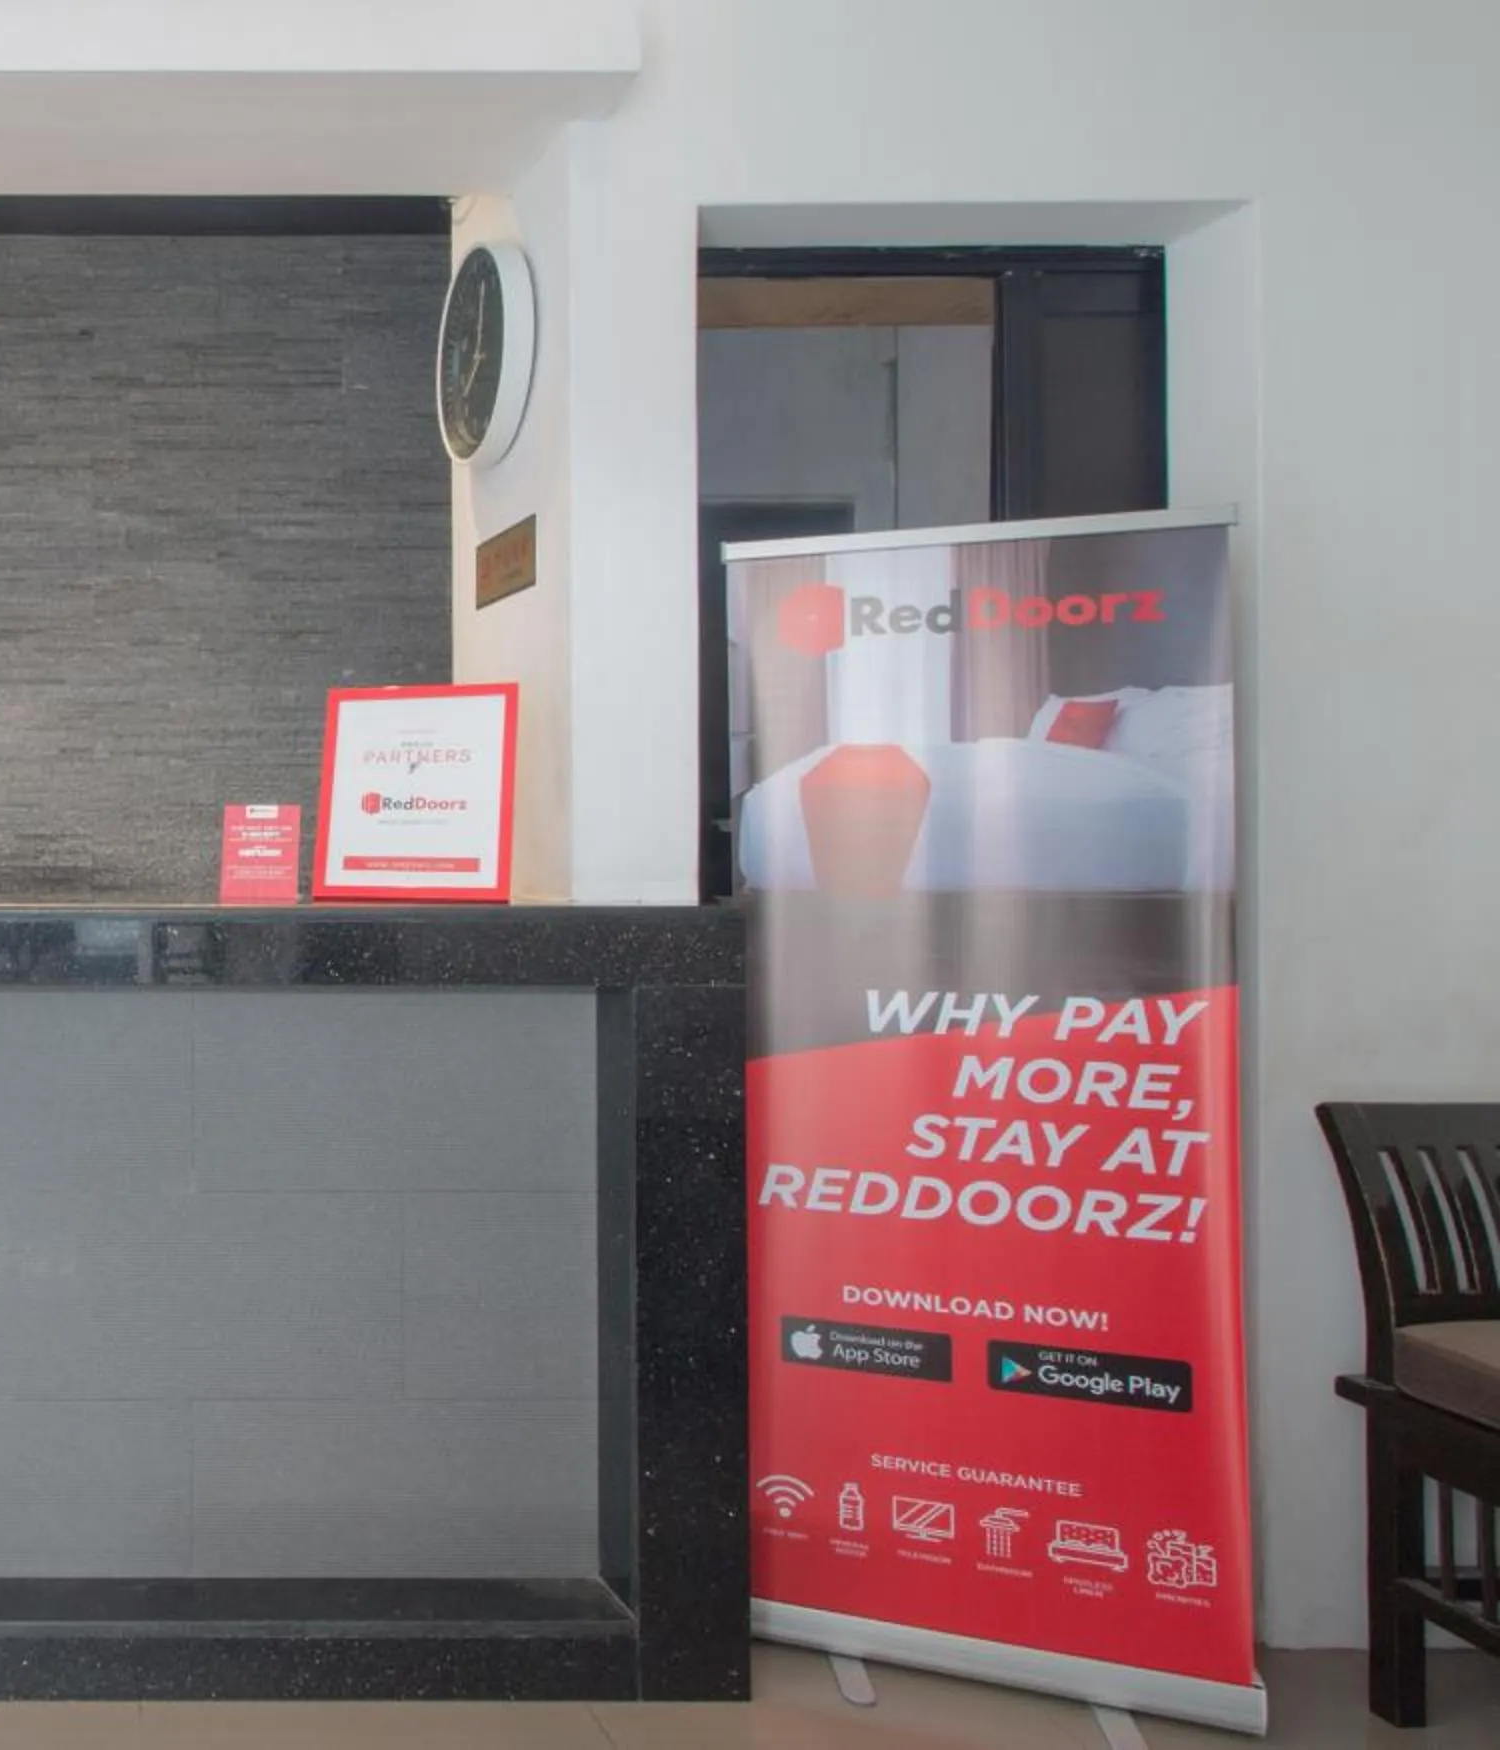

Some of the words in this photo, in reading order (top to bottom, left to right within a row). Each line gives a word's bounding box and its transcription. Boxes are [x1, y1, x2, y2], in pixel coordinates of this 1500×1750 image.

[850, 587, 1167, 636] RedDoorz
[363, 748, 472, 764] PARTNERS
[382, 794, 467, 811] RedDoorz
[866, 989, 1039, 1038] WHY
[1054, 996, 1210, 1046] PAY
[952, 1055, 1195, 1121] MORE,
[906, 1114, 1090, 1168] STAY
[1101, 1127, 1211, 1178] AT
[758, 1164, 1208, 1244] REDDOORZ!
[841, 1285, 1015, 1321] DOWNLOAD
[1022, 1306, 1110, 1332] NOW!
[829, 1330, 886, 1347] Download
[832, 1343, 870, 1365] App
[872, 1347, 922, 1369] Store
[1037, 1350, 1064, 1363] GET
[1037, 1364, 1125, 1396] Google
[1127, 1374, 1183, 1405] Play
[870, 1453, 952, 1479] SERVICE
[957, 1466, 1084, 1498] GUARANTEE
